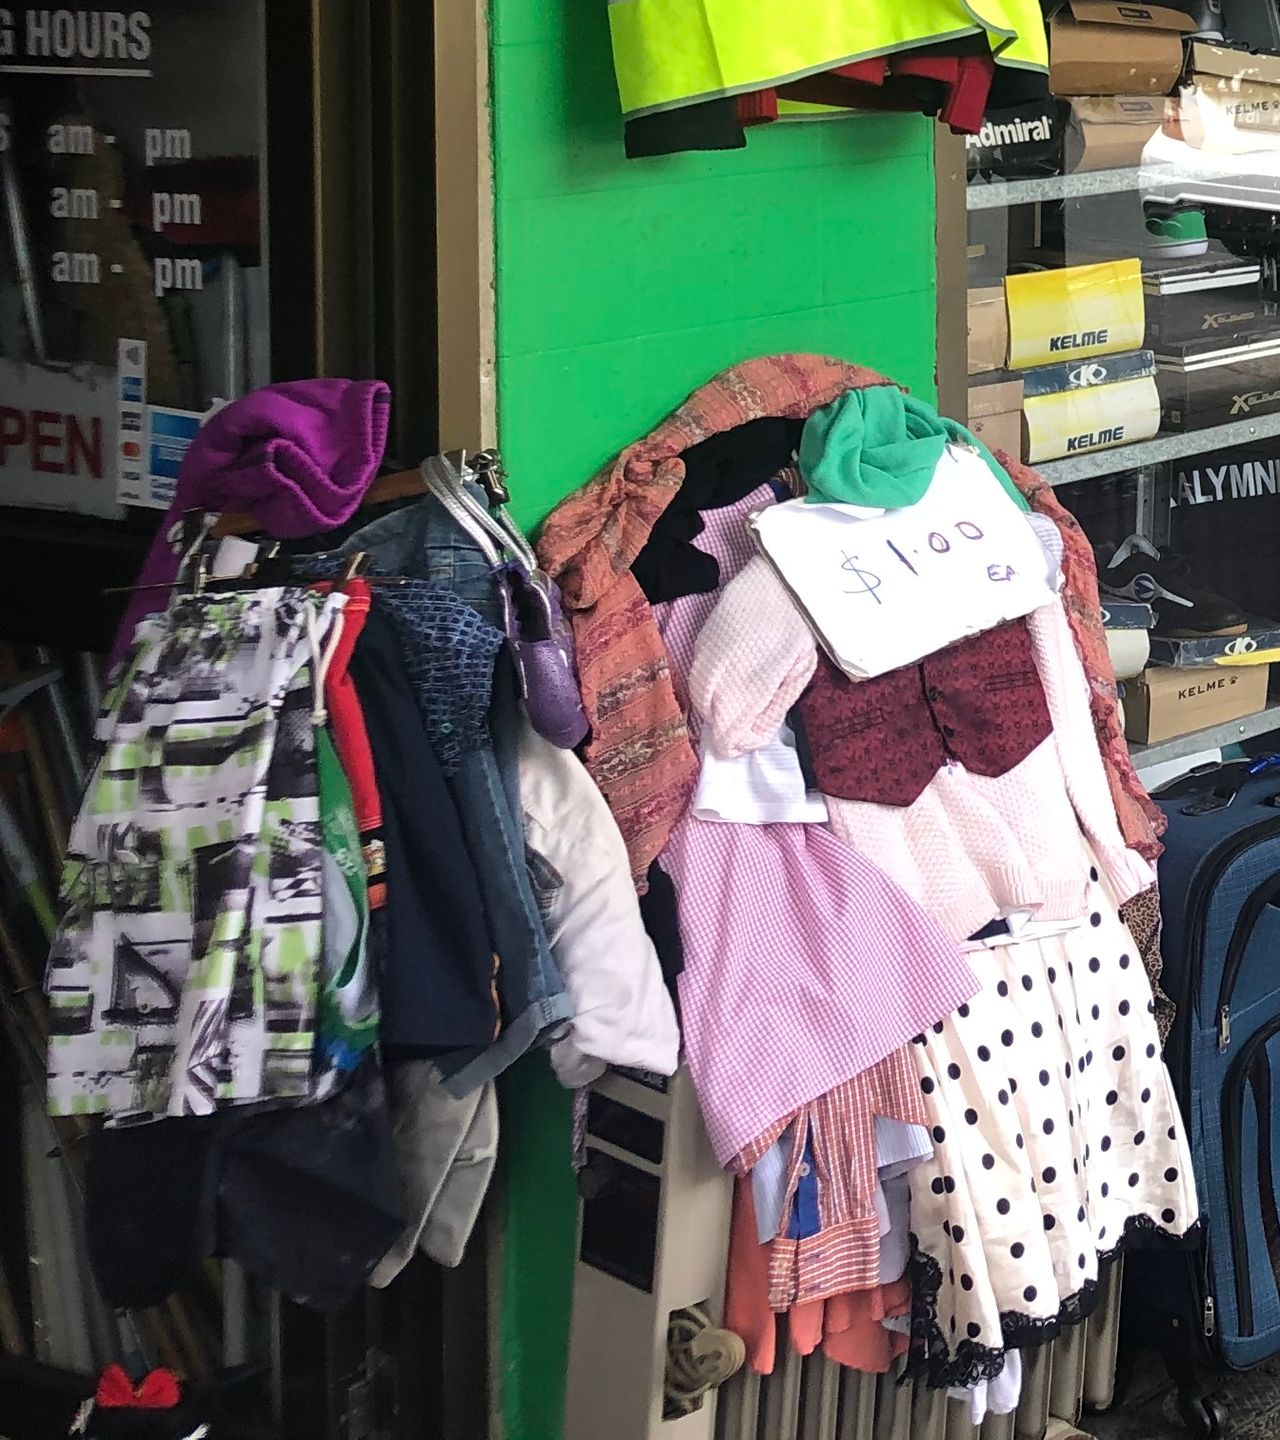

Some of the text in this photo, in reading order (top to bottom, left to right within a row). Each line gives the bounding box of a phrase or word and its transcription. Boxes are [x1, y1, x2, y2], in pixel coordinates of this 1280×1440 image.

[26, 9, 151, 60] HOURS
[1226, 100, 1270, 116] KELME
[48, 124, 95, 155] am
[145, 128, 192, 166] pm
[965, 115, 1052, 149] Admiral
[51, 187, 98, 219] am
[153, 192, 202, 232] pm
[52, 251, 100, 284] am
[155, 257, 203, 297] pm
[1050, 328, 1108, 352] KELME
[1066, 425, 1125, 453] KELME
[1178, 678, 1226, 701] KELME
